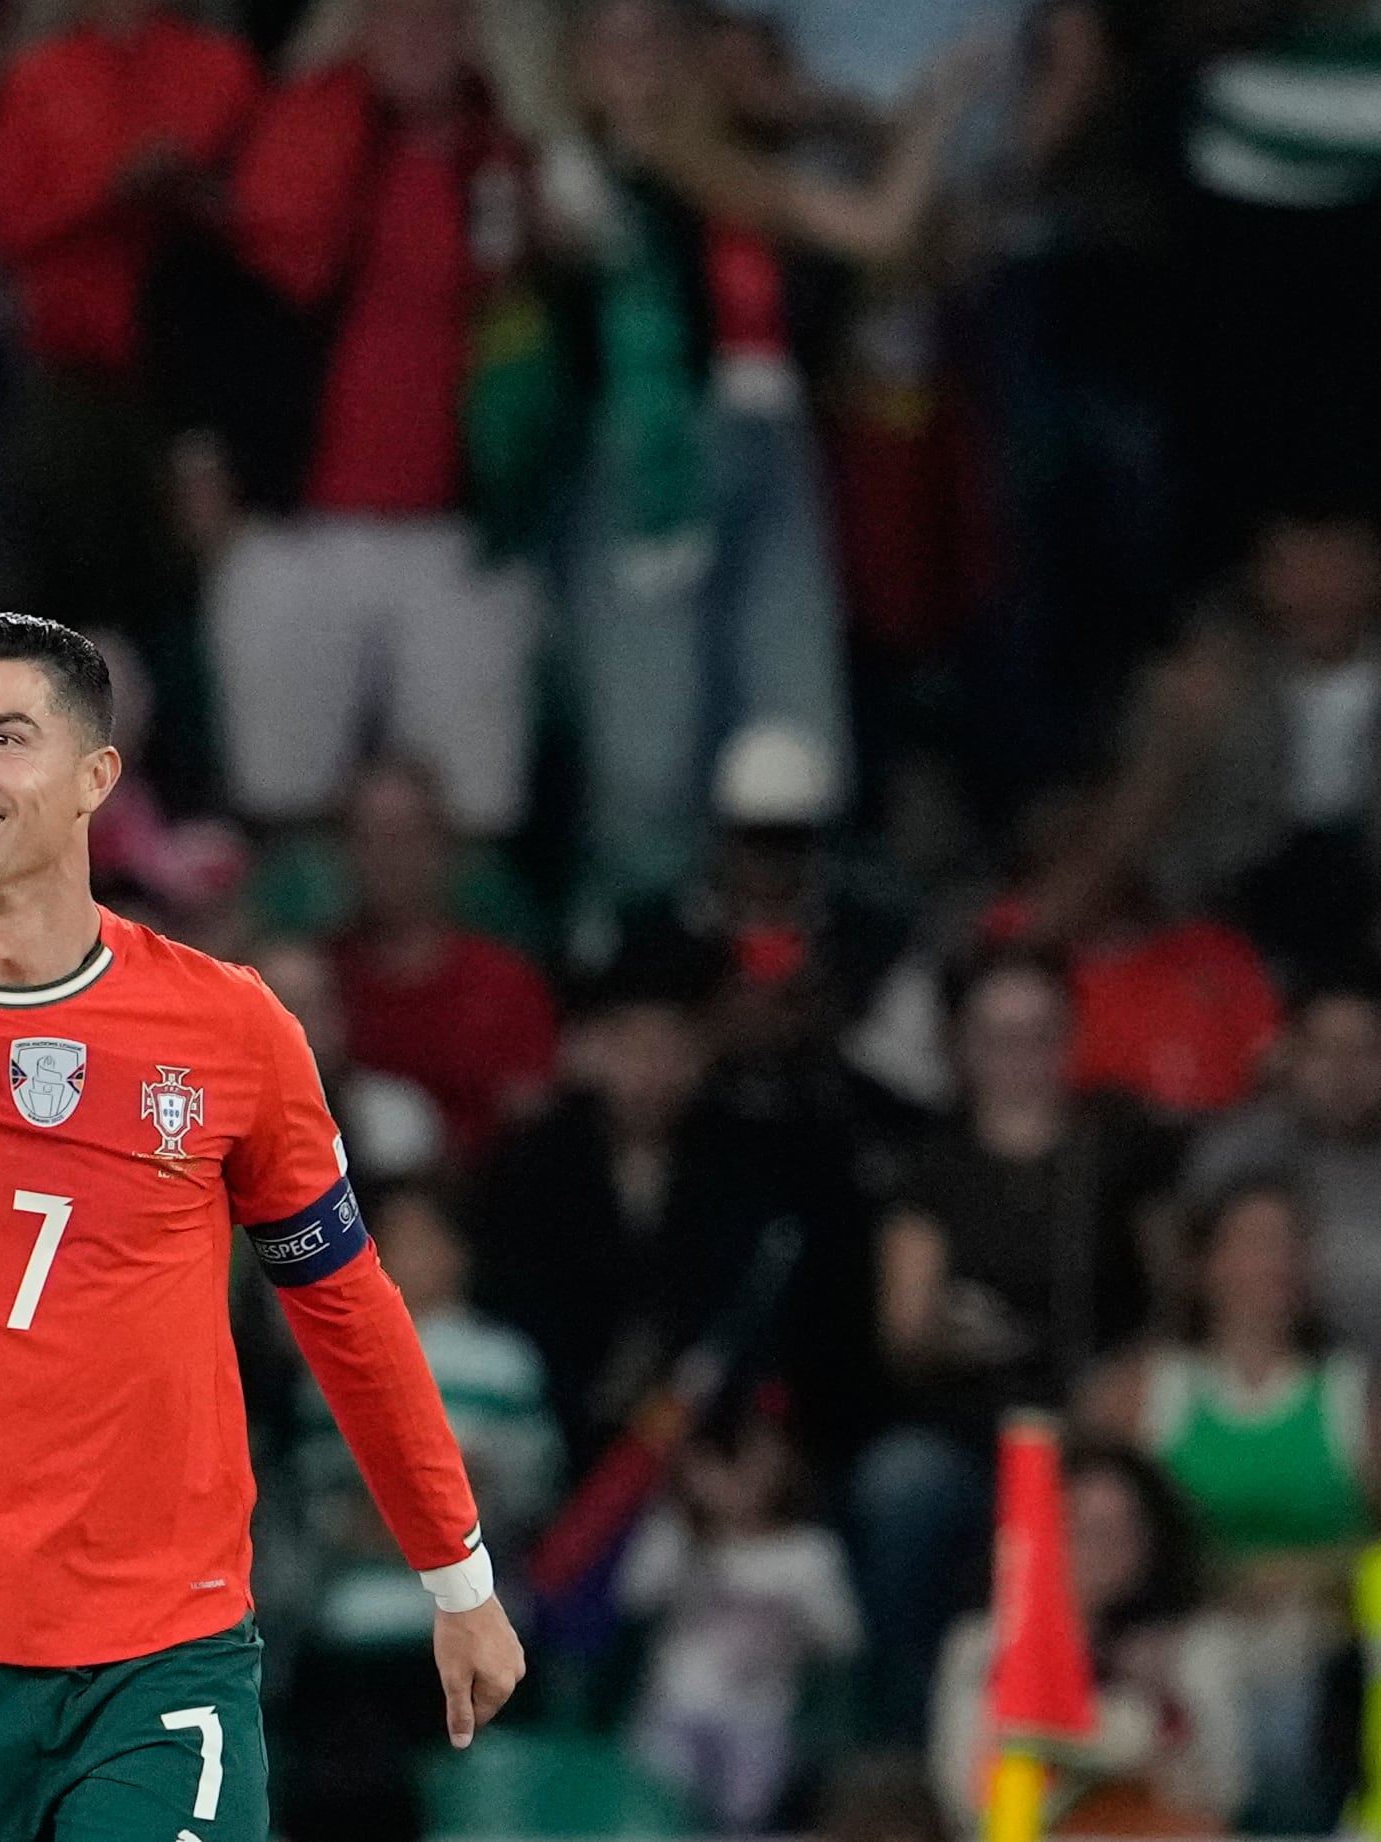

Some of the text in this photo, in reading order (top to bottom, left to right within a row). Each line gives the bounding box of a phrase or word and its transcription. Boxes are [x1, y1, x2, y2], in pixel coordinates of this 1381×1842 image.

[6, 1189, 75, 1330] 7
[257, 1226, 324, 1260] ESPECT
[160, 1705, 224, 1821] 7
